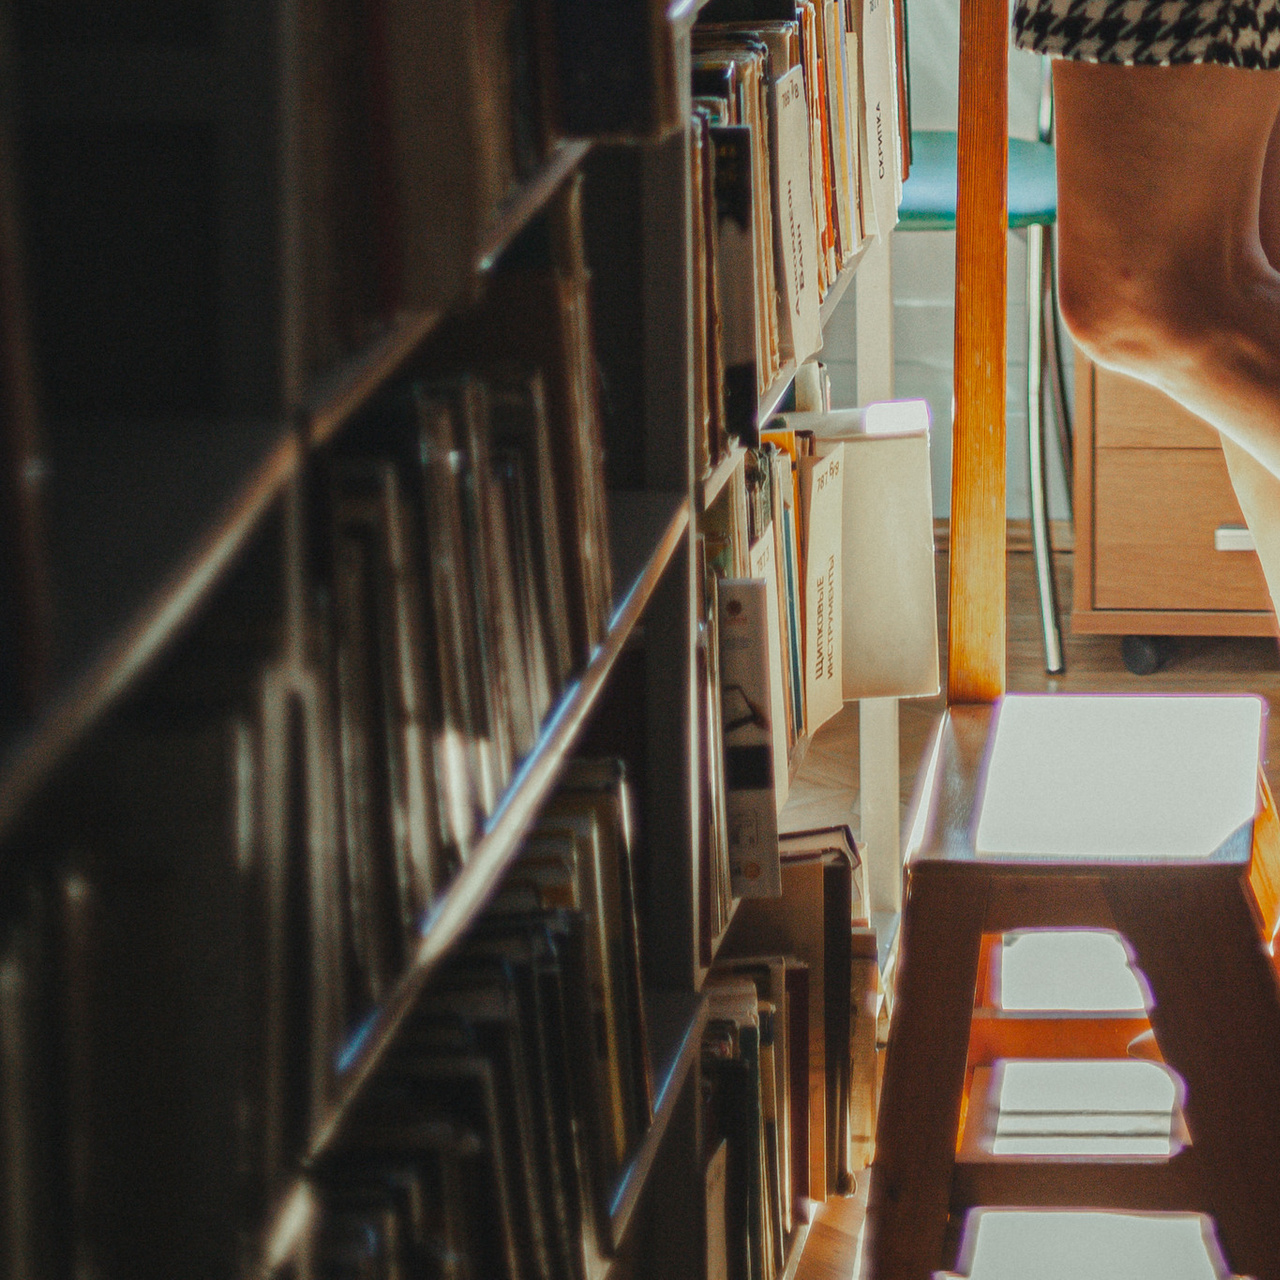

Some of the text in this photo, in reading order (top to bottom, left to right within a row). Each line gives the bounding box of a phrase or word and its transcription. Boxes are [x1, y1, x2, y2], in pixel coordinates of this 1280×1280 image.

[875, 101, 886, 179] СКРИПКА
[814, 575, 825, 681] ЩИПКОВЫЕ
[826, 554, 836, 681] ИНСТРУМЕНТЫ
